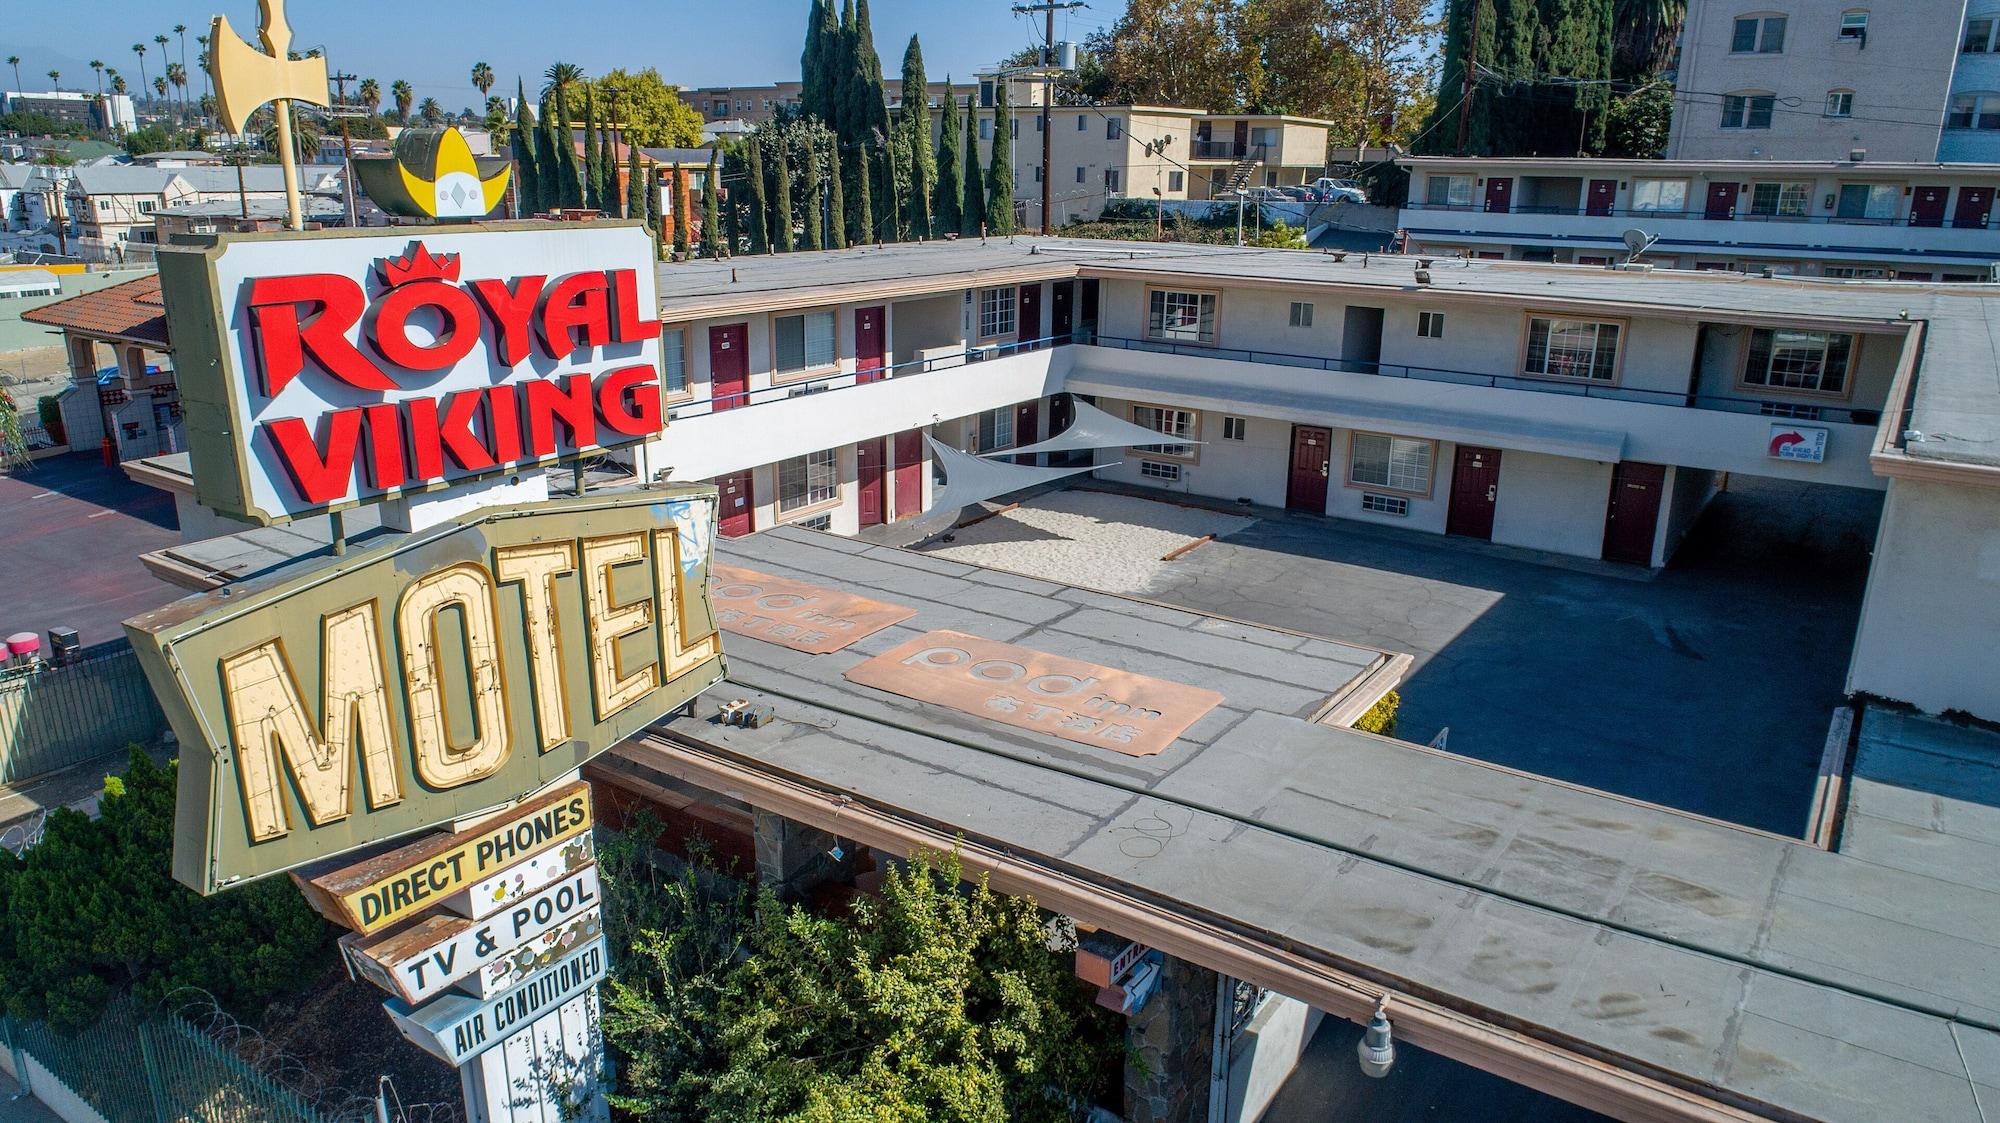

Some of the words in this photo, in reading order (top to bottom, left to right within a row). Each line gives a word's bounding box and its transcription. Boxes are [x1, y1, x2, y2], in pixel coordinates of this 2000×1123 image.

[249, 269, 661, 398] ROYAL
[261, 364, 662, 504] VIKING
[219, 527, 719, 845] MOTEL
[360, 850, 466, 926] DIRECT
[475, 797, 586, 873] PHONES
[408, 942, 457, 991] TV
[475, 925, 499, 959] &
[511, 884, 594, 939] POOL
[454, 1014, 487, 1057] AIR
[493, 945, 601, 1032] CONDITIONED
